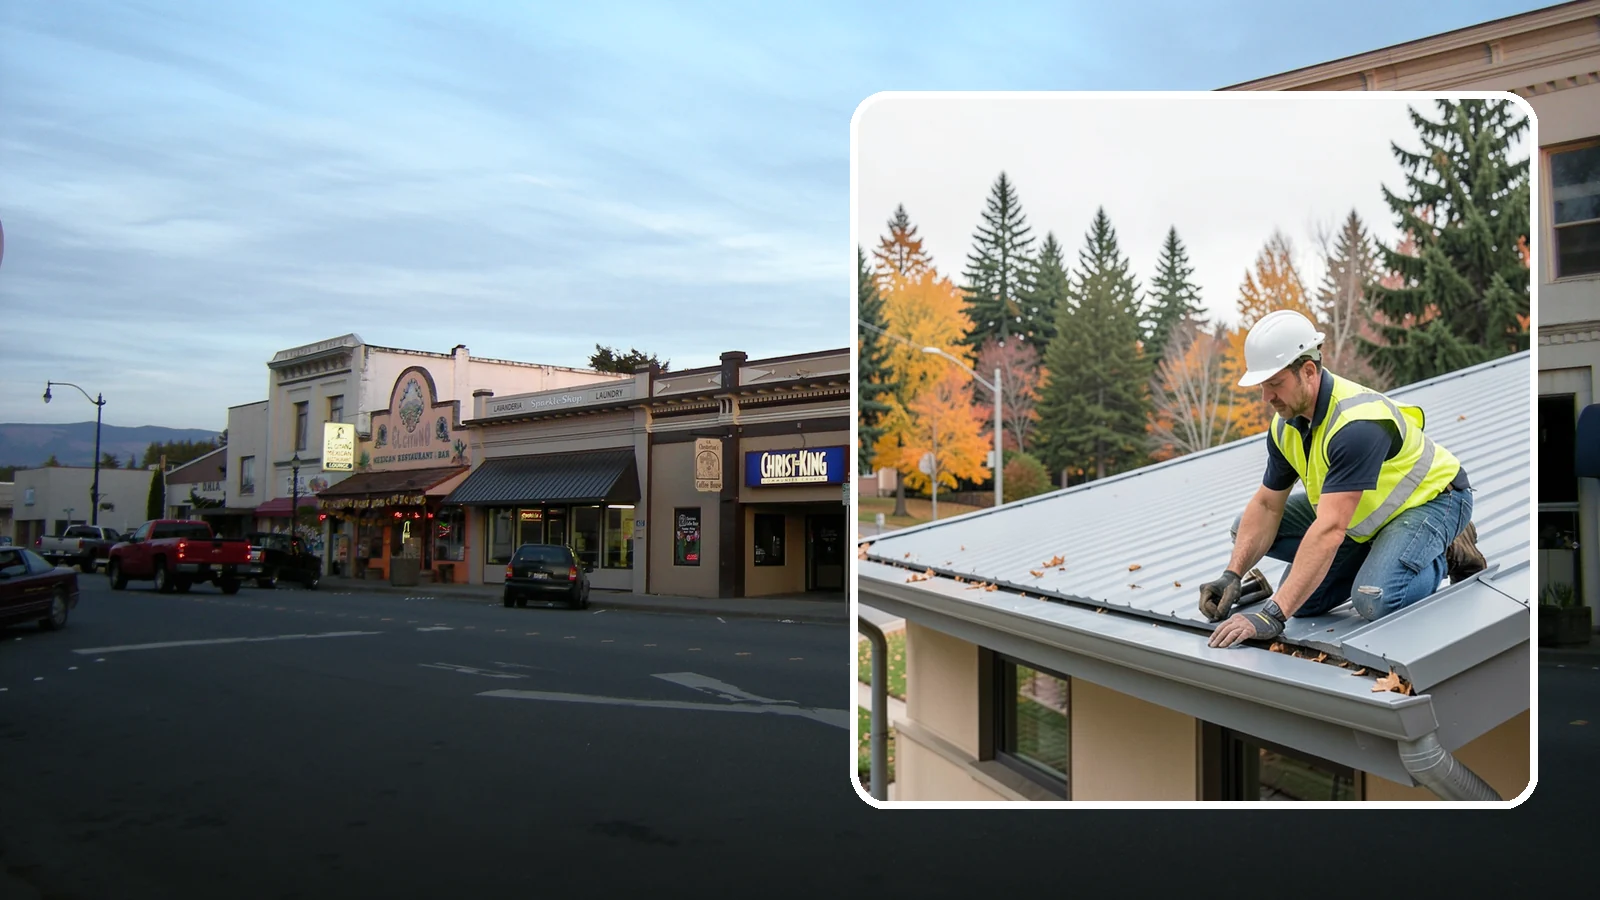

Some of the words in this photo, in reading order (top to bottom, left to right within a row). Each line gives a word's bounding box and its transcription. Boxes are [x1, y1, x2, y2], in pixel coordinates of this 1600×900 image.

[596, 389, 623, 400] LAUNDRY
[494, 402, 522, 412] LAVANDERIA
[531, 398, 561, 410] Sparkle
[562, 395, 582, 406] Shop
[397, 451, 433, 462] RESTAURANT
[437, 449, 450, 459] BAR
[761, 452, 798, 478] CHRIST
[799, 450, 827, 476] KING
